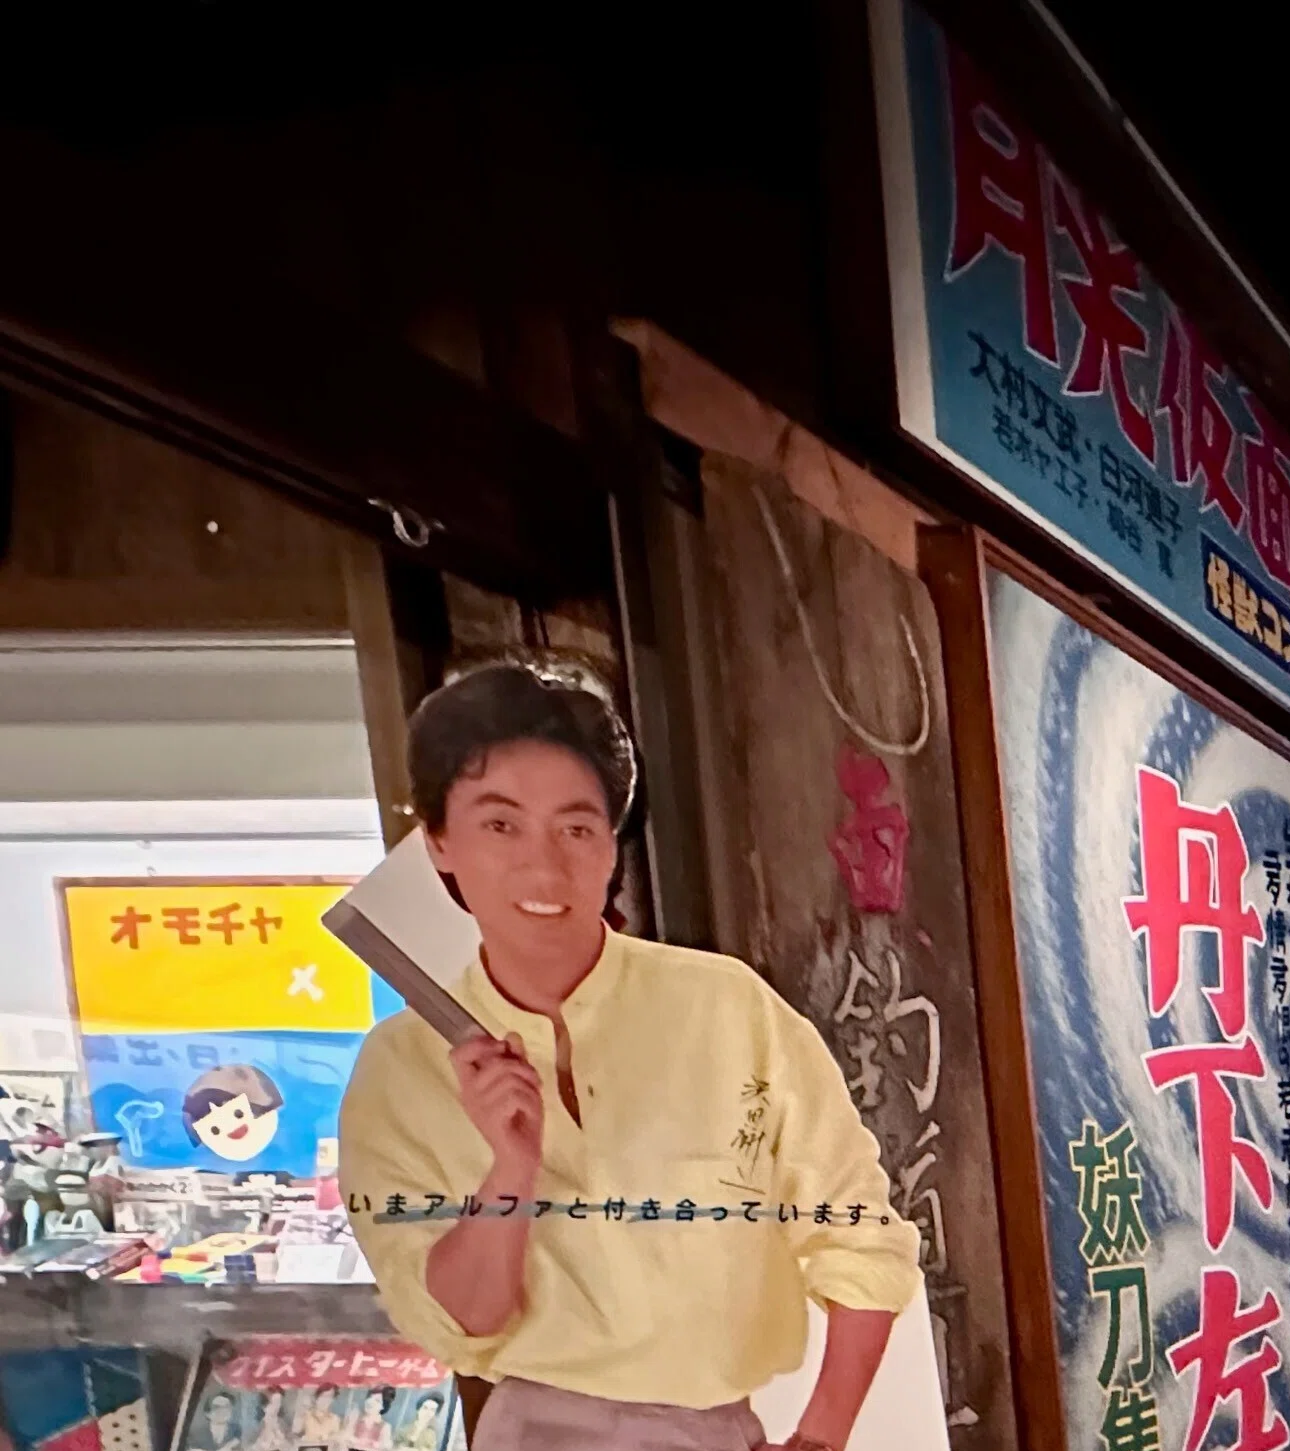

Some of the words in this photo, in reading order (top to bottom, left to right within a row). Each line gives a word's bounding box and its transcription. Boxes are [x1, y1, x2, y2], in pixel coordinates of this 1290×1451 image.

[349, 1191, 891, 1227] いまアルファと付き合っています。
